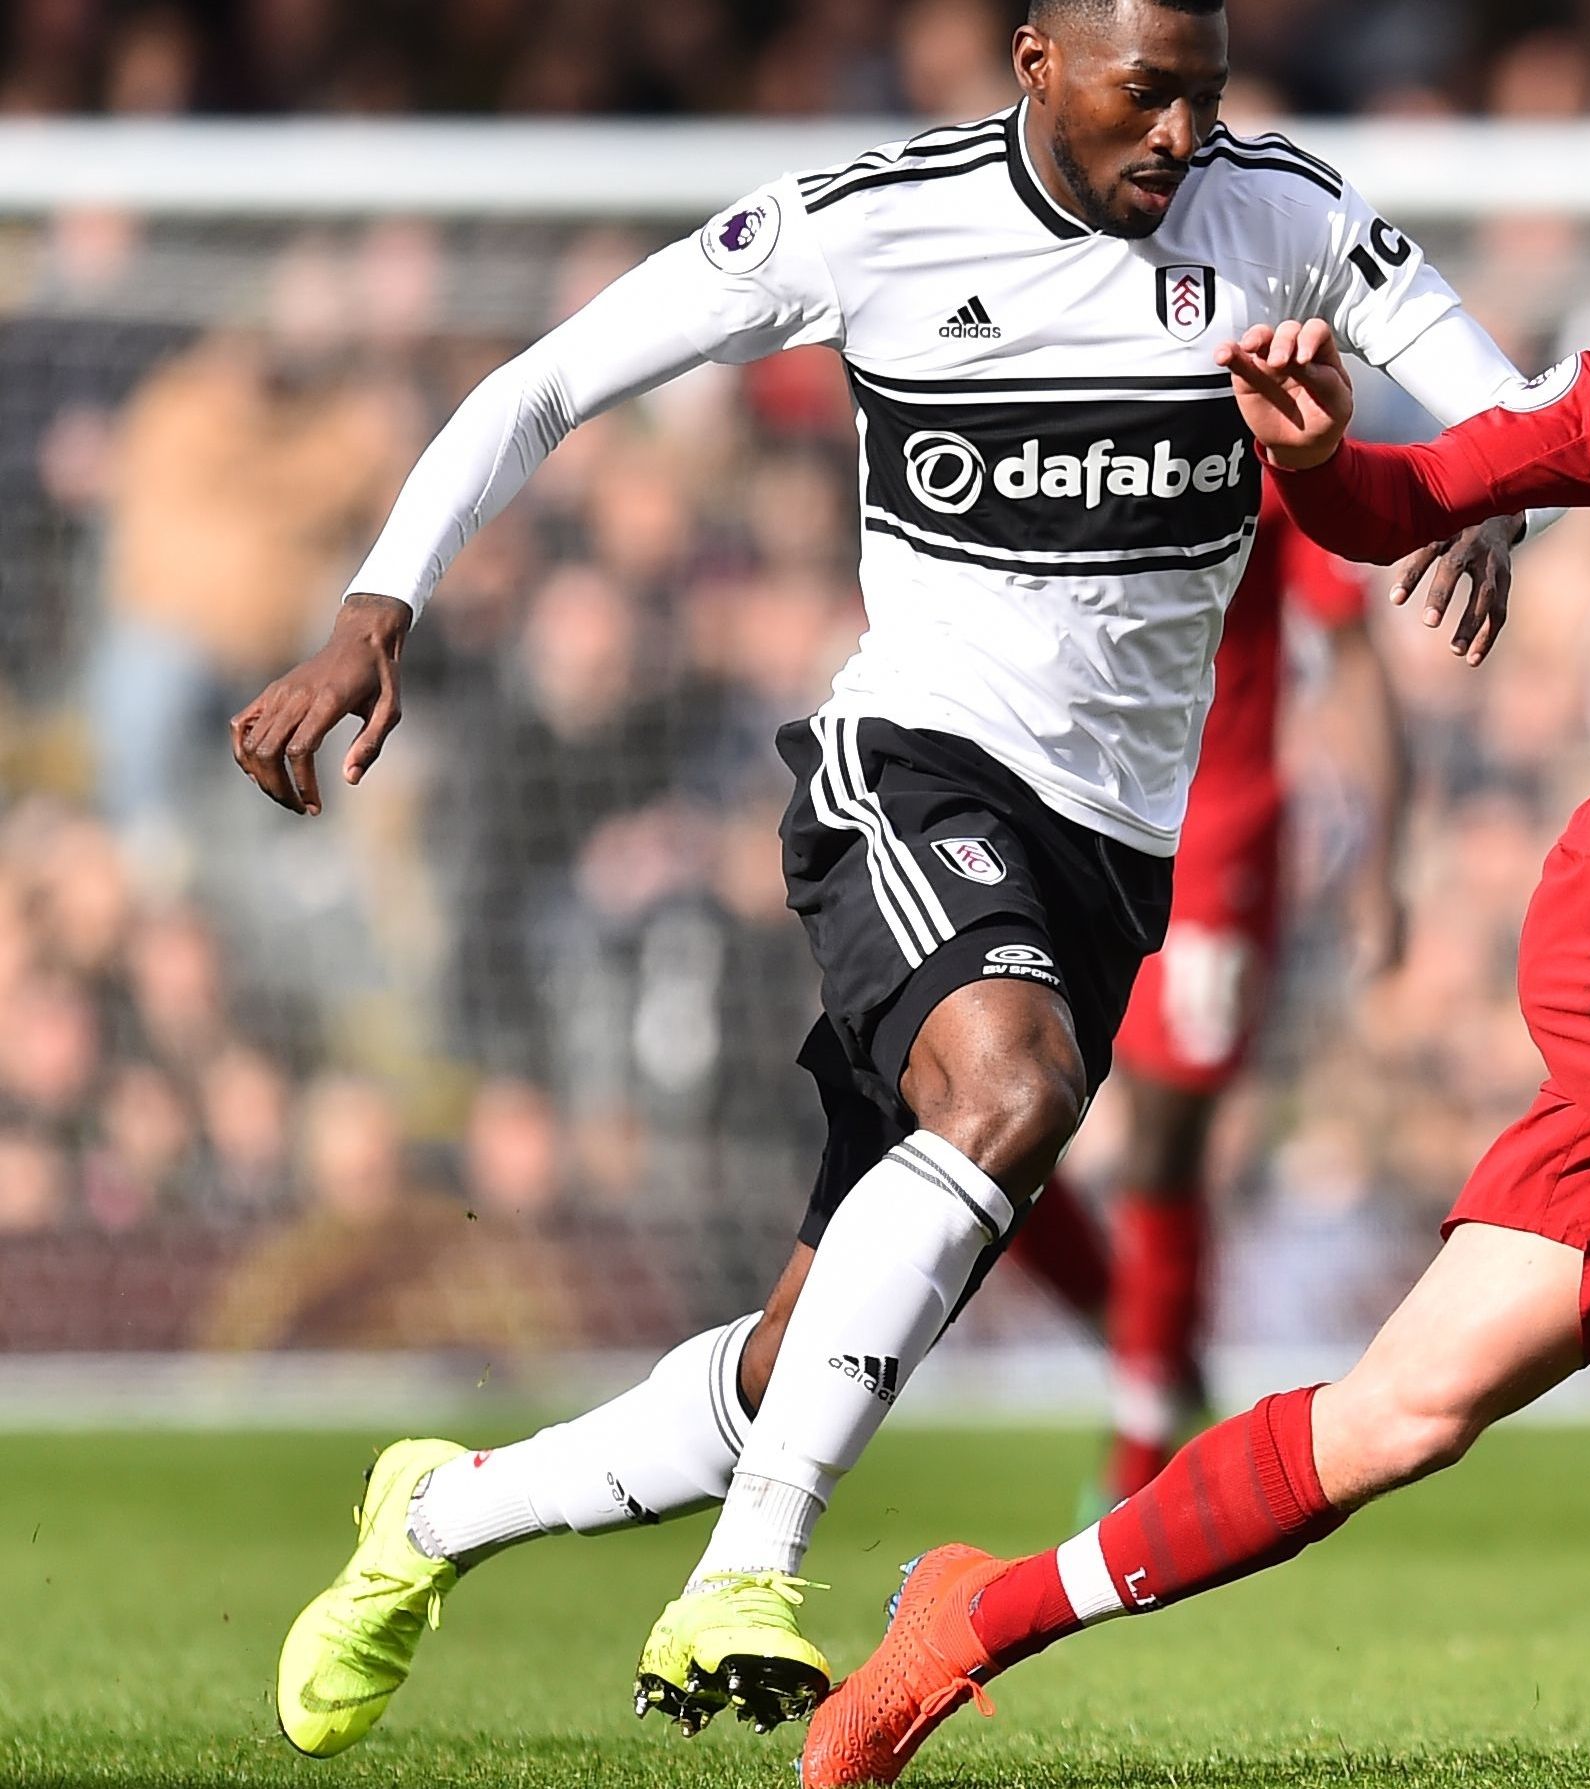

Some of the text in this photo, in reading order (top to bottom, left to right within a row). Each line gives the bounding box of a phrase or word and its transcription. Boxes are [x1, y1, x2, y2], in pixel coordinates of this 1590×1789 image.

[938, 322, 1002, 339] adidas
[992, 438, 1246, 510] dafabet
[828, 1357, 897, 1407] adidas
